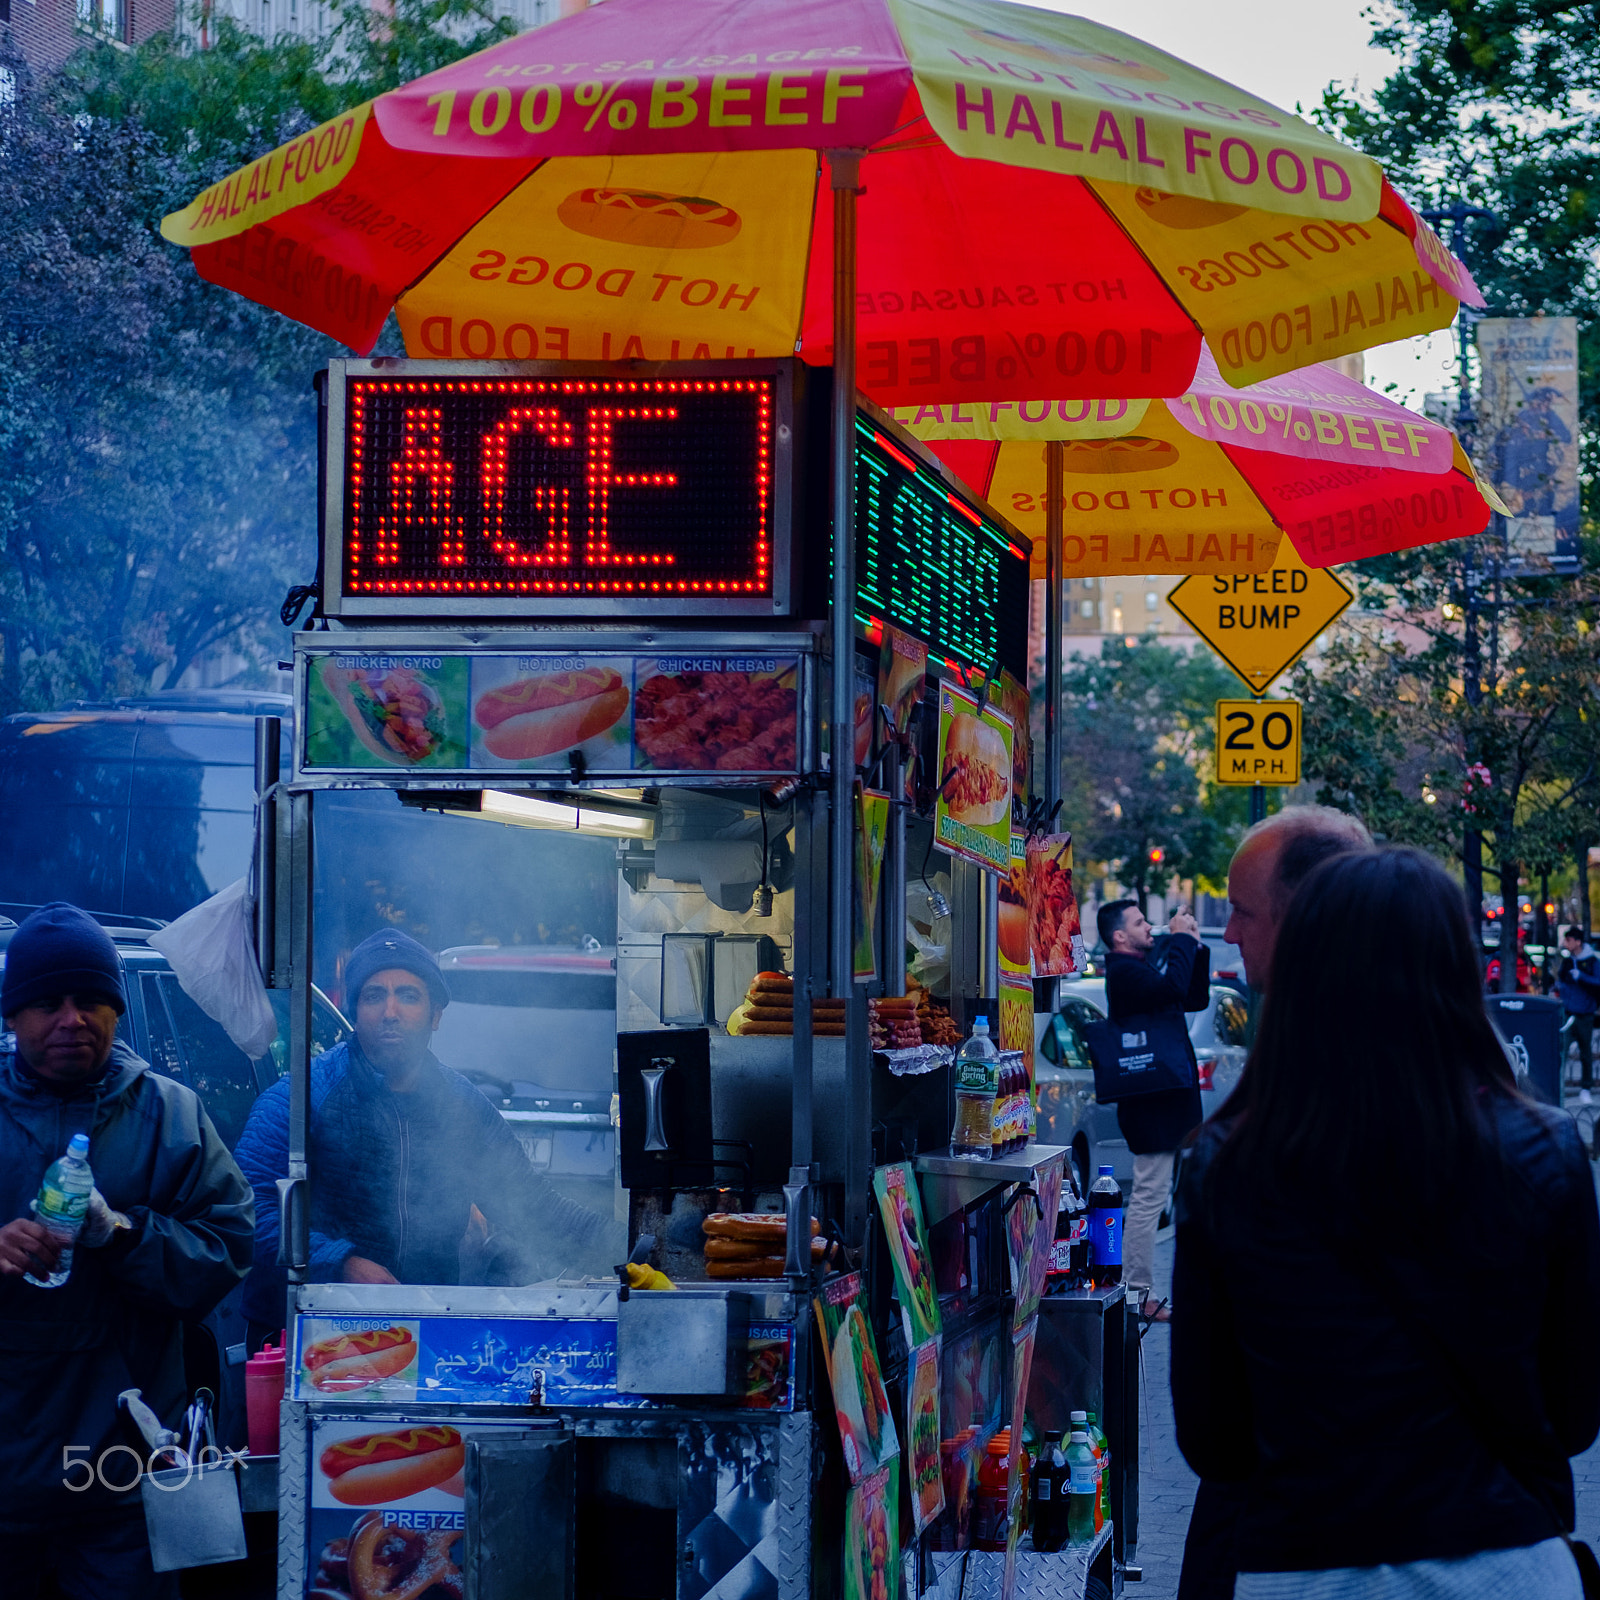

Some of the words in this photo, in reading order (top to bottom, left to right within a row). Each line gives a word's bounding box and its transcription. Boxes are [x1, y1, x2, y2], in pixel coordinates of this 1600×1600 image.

[485, 62, 576, 78] HOT
[591, 45, 863, 74] SAUSAGES
[948, 48, 1079, 90] HOT
[1099, 82, 1283, 128] DOGS
[955, 82, 1165, 167] HALAL
[1184, 127, 1352, 202] FOOD
[189, 156, 273, 230] HALAL
[278, 117, 354, 192] FOOD
[1242, 383, 1384, 410] AUSAGES
[887, 402, 974, 425] LAL
[375, 409, 679, 563] AGE
[1212, 570, 1308, 594] SPEED
[1218, 605, 1300, 629] BUMP
[336, 656, 399, 670] CHICKEN
[402, 656, 442, 670] GYRO
[518, 657, 550, 671] HOT
[553, 657, 585, 671] DOG
[657, 658, 721, 672] CHICKEN
[726, 659, 776, 673] KEBAB
[1224, 711, 1292, 751] 20
[961, 1072, 986, 1084] Spring
[332, 1320, 358, 1331] HOT
[362, 1320, 390, 1331] DOG
[384, 1511, 465, 1530] PRETZE
